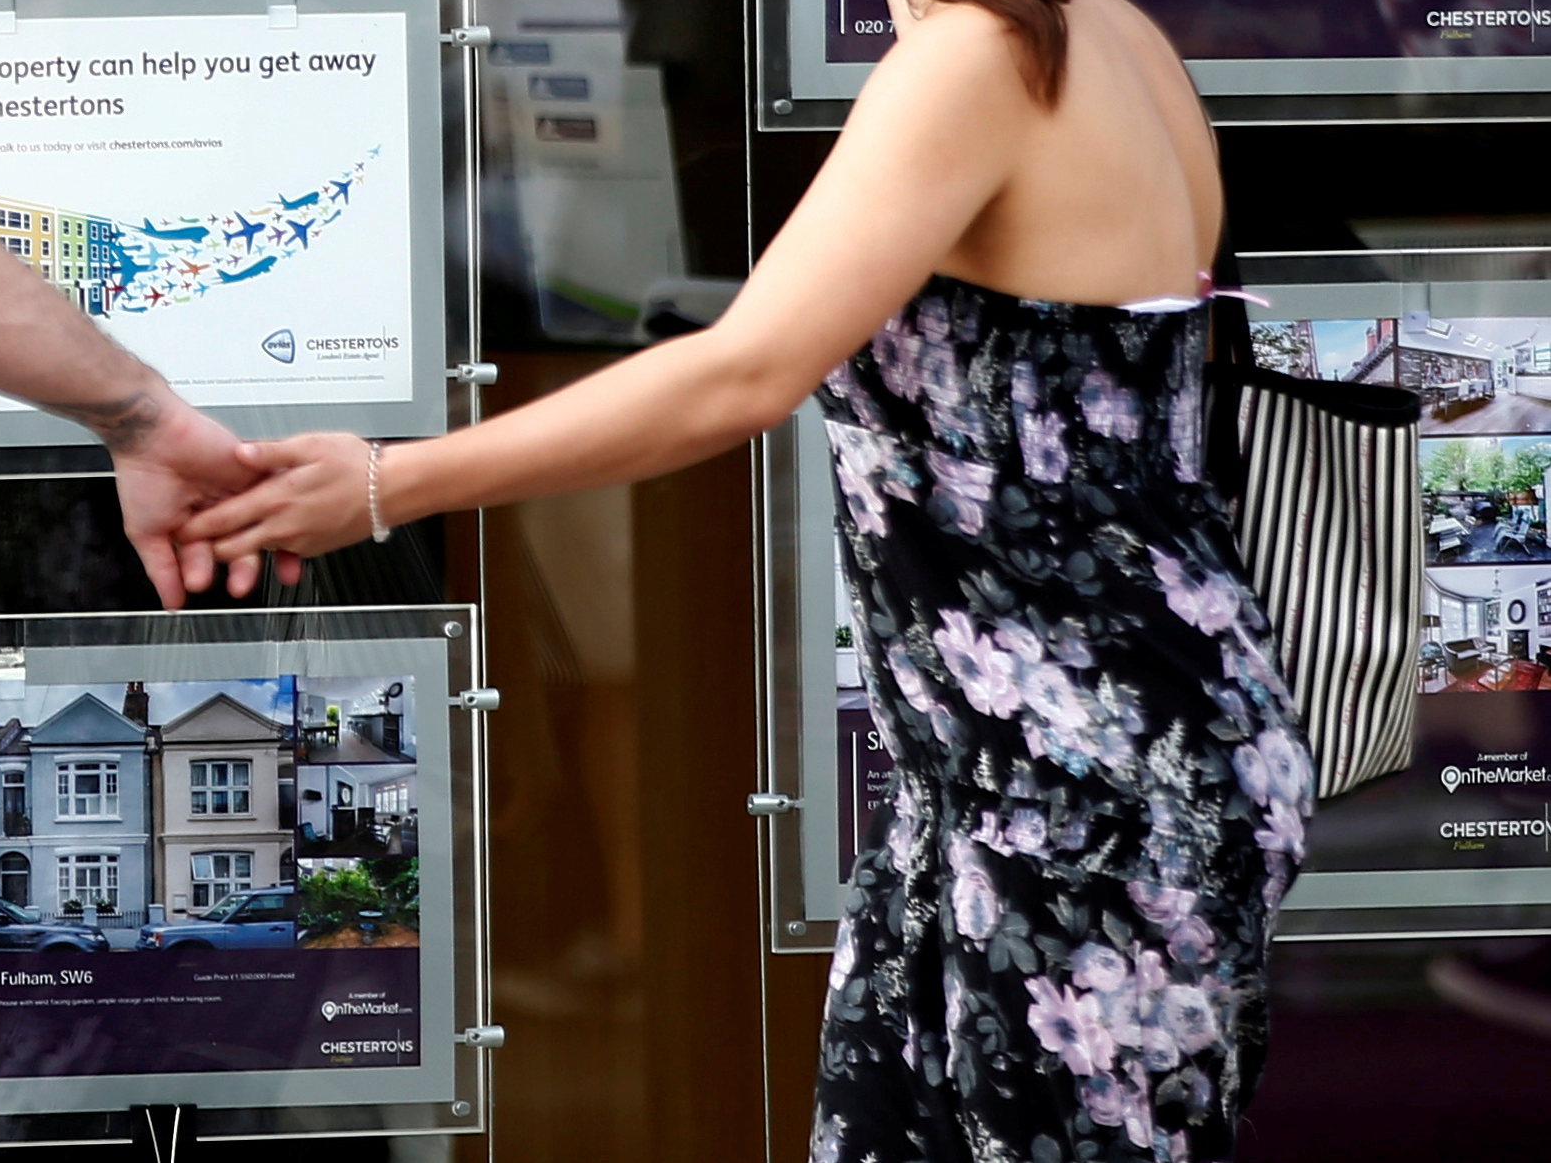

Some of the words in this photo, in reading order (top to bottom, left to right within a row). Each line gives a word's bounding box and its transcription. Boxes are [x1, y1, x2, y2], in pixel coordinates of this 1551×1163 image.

[1427, 10, 1551, 26] CHESTERTONS
[855, 20, 884, 34] 020
[89, 59, 133, 76] can
[142, 52, 196, 79] help
[204, 57, 250, 80] you
[259, 52, 300, 79] get
[308, 54, 376, 76] away
[16, 143, 27, 152] to
[29, 144, 41, 152] us
[42, 141, 72, 153] today
[73, 143, 84, 151] or
[86, 141, 106, 150] visit
[108, 139, 222, 149] chestertons.com/avios
[306, 337, 399, 350] CHESTERTONS
[1440, 765, 1551, 793] OnTheMarket.c
[1, 971, 56, 985] Fulham,
[60, 970, 92, 984] SW6
[321, 1041, 413, 1054] CHESTERTONS
